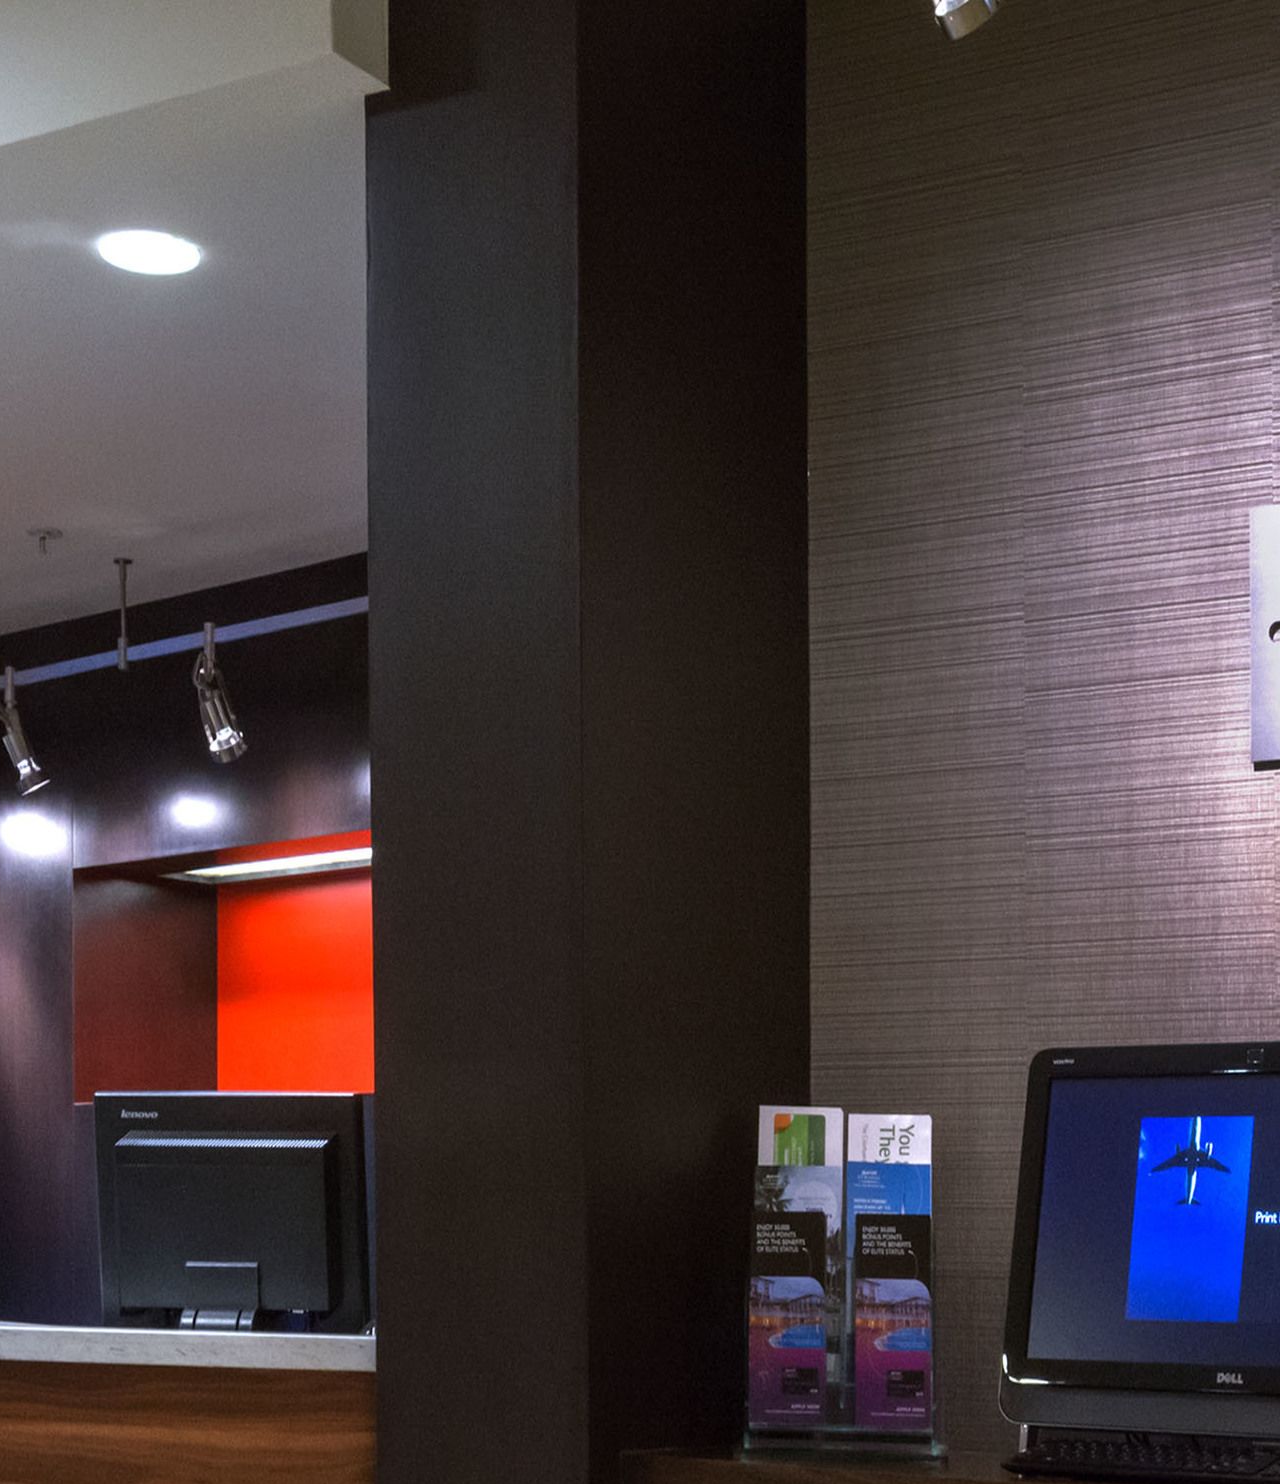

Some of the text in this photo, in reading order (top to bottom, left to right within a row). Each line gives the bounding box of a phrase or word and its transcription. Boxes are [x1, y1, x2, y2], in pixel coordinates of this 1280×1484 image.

[121, 1108, 159, 1120] lenovo
[899, 1124, 915, 1156] You
[1255, 1210, 1278, 1224] Print
[1217, 1372, 1244, 1384] DELL
